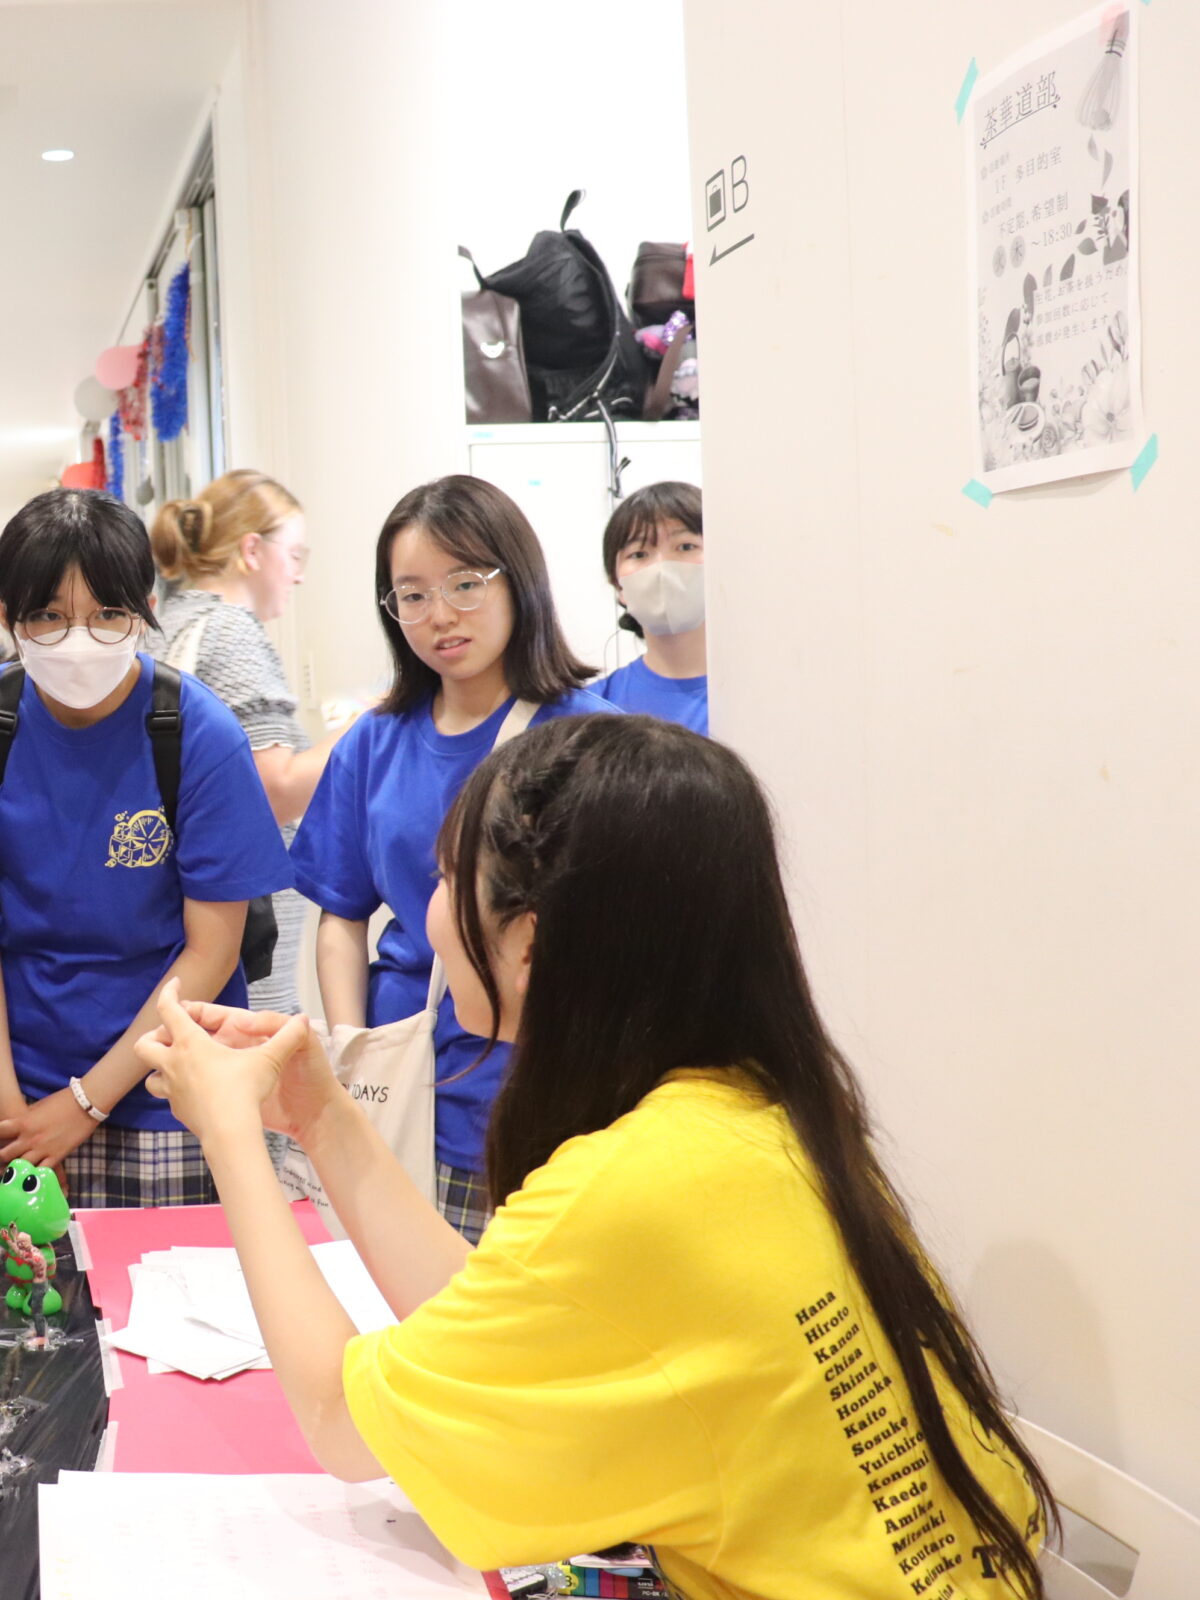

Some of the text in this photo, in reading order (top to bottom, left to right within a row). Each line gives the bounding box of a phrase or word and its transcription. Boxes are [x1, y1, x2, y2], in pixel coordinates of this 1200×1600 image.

[984, 70, 1057, 139] 茶華道部
[795, 1291, 836, 1325] Hana
[804, 1306, 849, 1345] Hiroto
[814, 1323, 860, 1364] Kanon
[824, 1347, 863, 1382] Chisa
[830, 1361, 878, 1402] Shinta
[836, 1375, 893, 1420] Honoka
[843, 1406, 887, 1439] Kaito
[851, 1416, 909, 1457] Sosuke
[859, 1431, 925, 1476] Yuichiro
[867, 1449, 930, 1494] Konomi
[872, 1481, 928, 1513] Kaede
[898, 1533, 956, 1575] Koutaro
[910, 1554, 962, 1596] Keisuke
